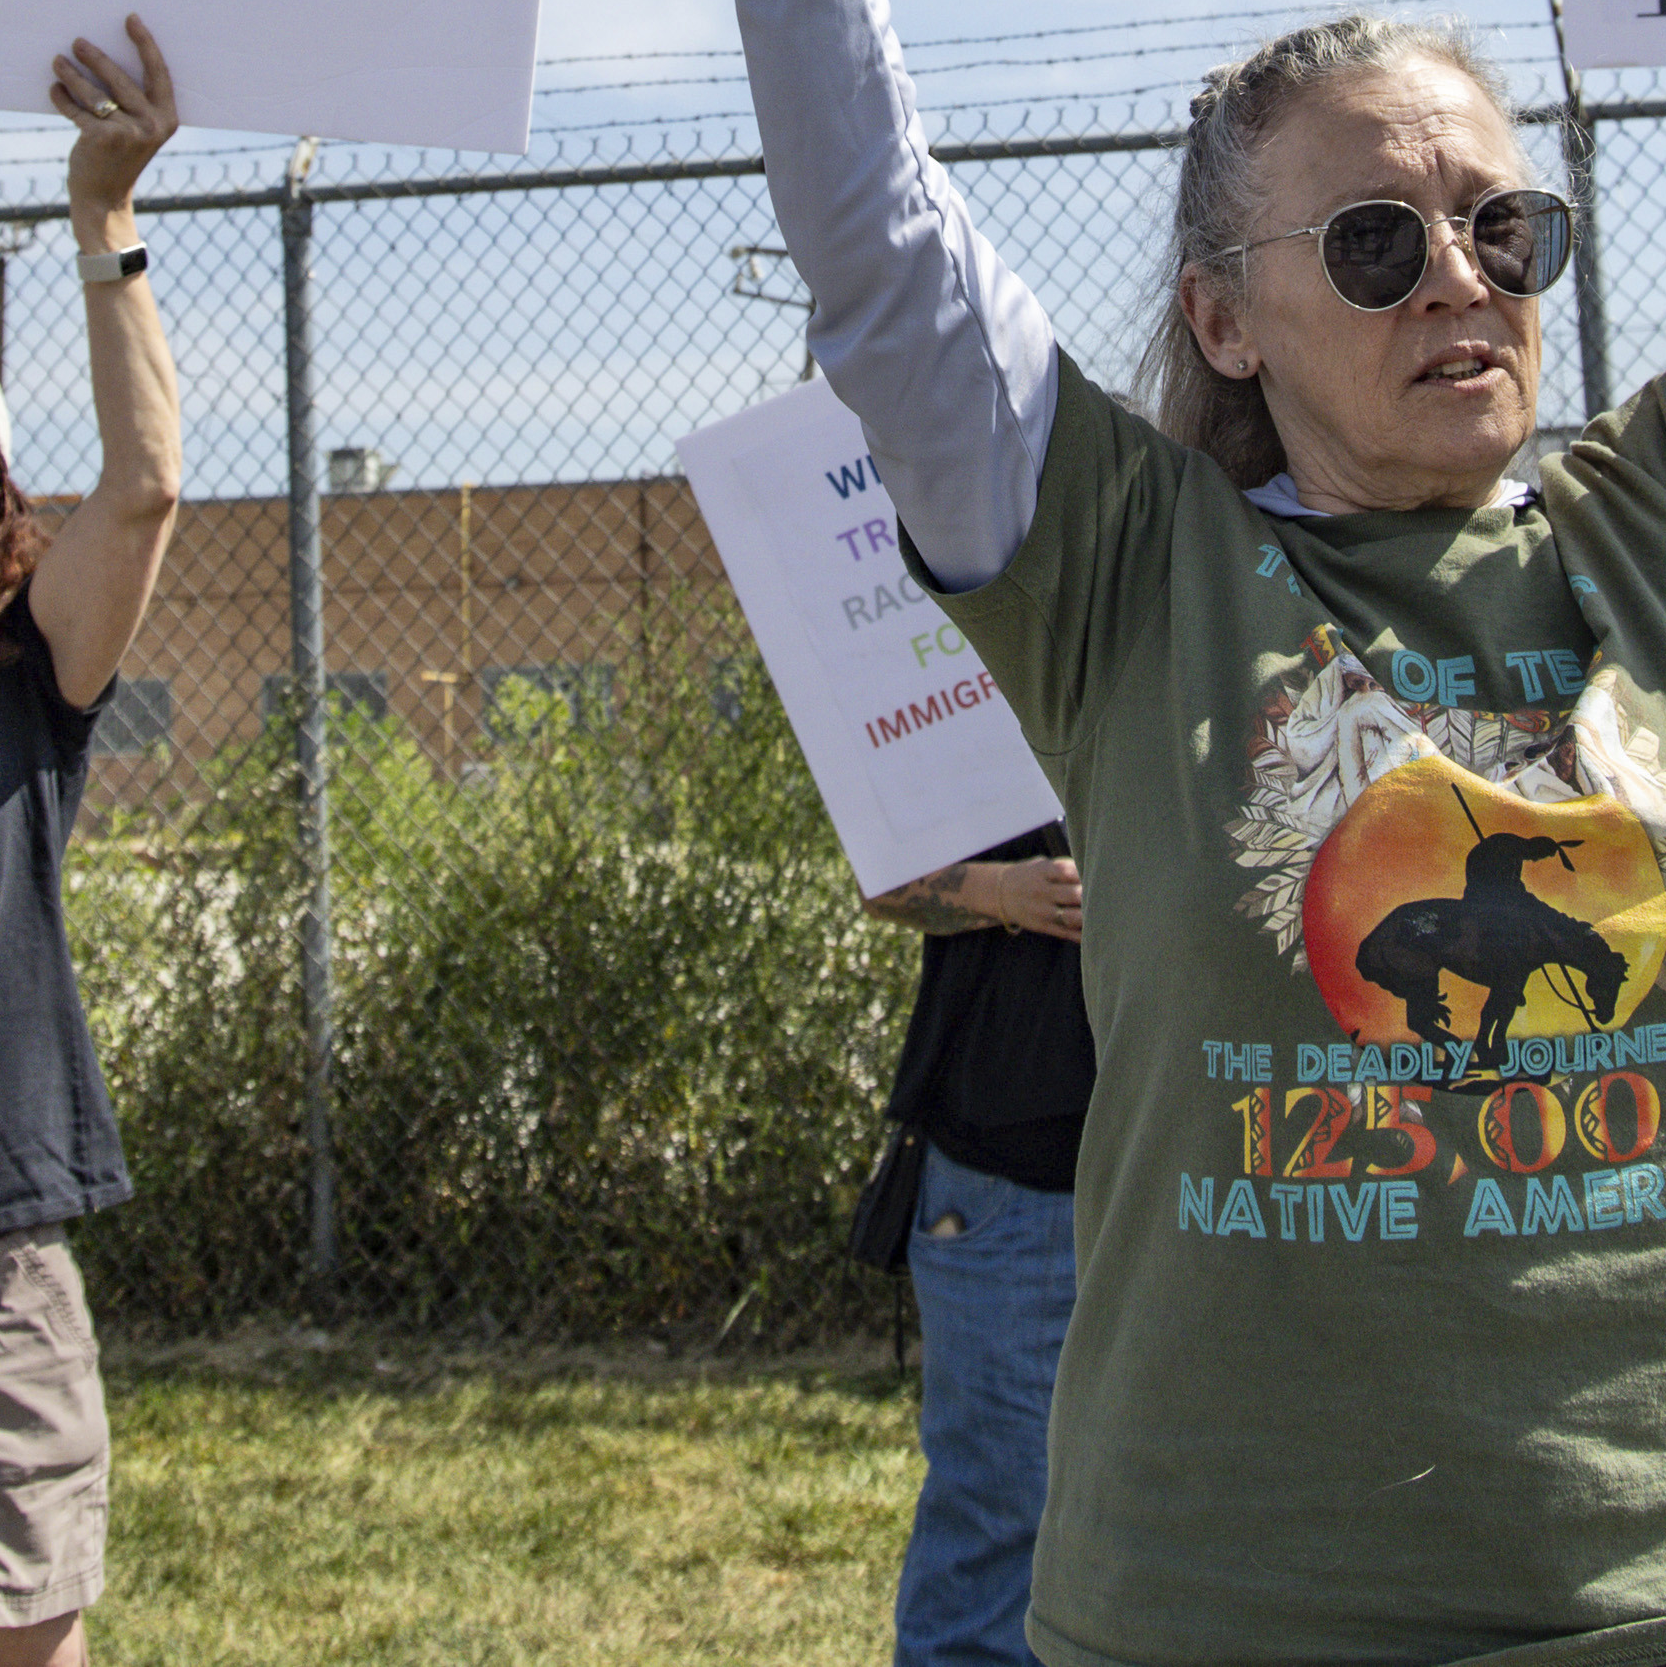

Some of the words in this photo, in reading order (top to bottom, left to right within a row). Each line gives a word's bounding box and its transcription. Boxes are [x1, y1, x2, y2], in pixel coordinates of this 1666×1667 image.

[1392, 649, 1476, 707] OF
[1202, 1039, 1273, 1082] THE
[1296, 1040, 1474, 1083] DEADLY
[1178, 1171, 1420, 1242] NATIVE
